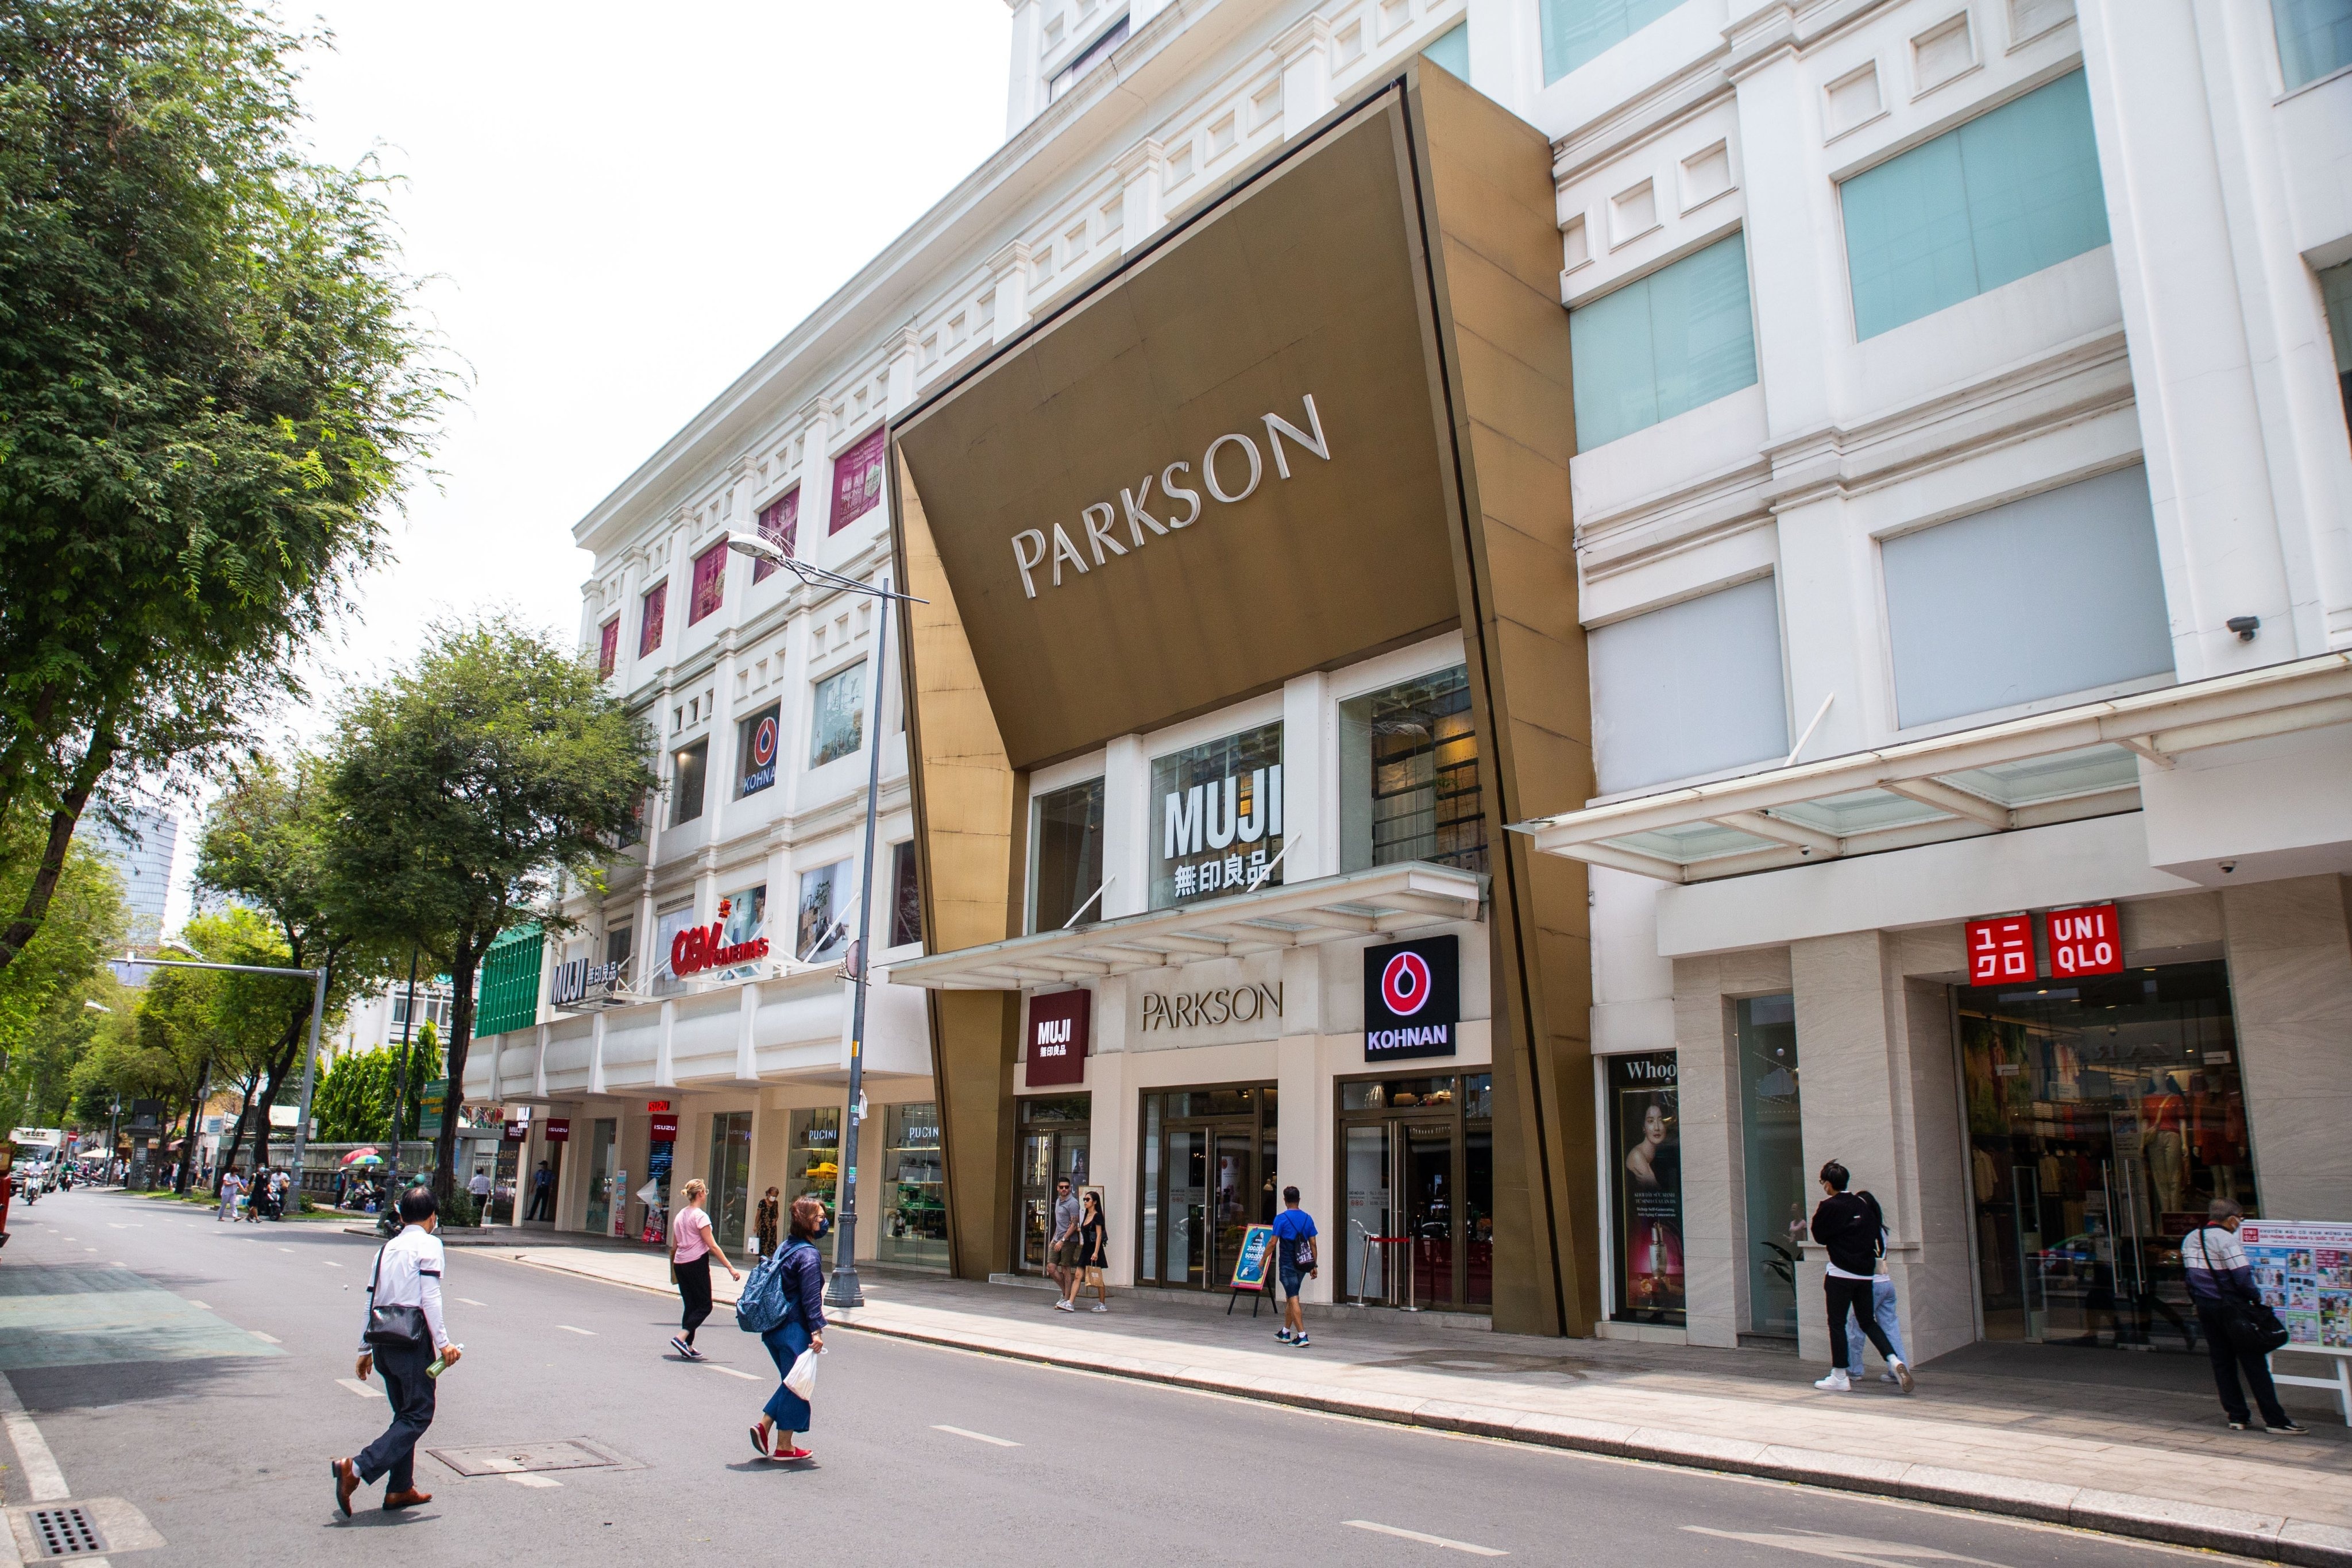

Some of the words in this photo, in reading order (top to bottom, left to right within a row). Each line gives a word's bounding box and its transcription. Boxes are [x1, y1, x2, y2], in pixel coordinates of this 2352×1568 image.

[1011, 393, 1330, 598] PARKSON
[1164, 764, 1283, 859] MUJI
[1174, 849, 1271, 899] 無印良品
[2054, 914, 2105, 941] UNI
[671, 921, 723, 976] CGV
[713, 937, 770, 966] CINEMAS
[2057, 942, 2113, 973] QLO
[550, 957, 589, 1005] MUJI
[586, 961, 617, 986] 無印良品
[1140, 981, 1283, 1031] PARKSON
[1037, 1018, 1071, 1045] MUJI
[1368, 1024, 1447, 1050] KOHNAN
[1040, 1045, 1067, 1057] 無印良品
[1625, 1061, 1677, 1079] Whoo
[647, 1100, 670, 1112] ISUZU
[809, 1129, 836, 1140] PUCINI
[909, 1126, 939, 1139] PUCIN
